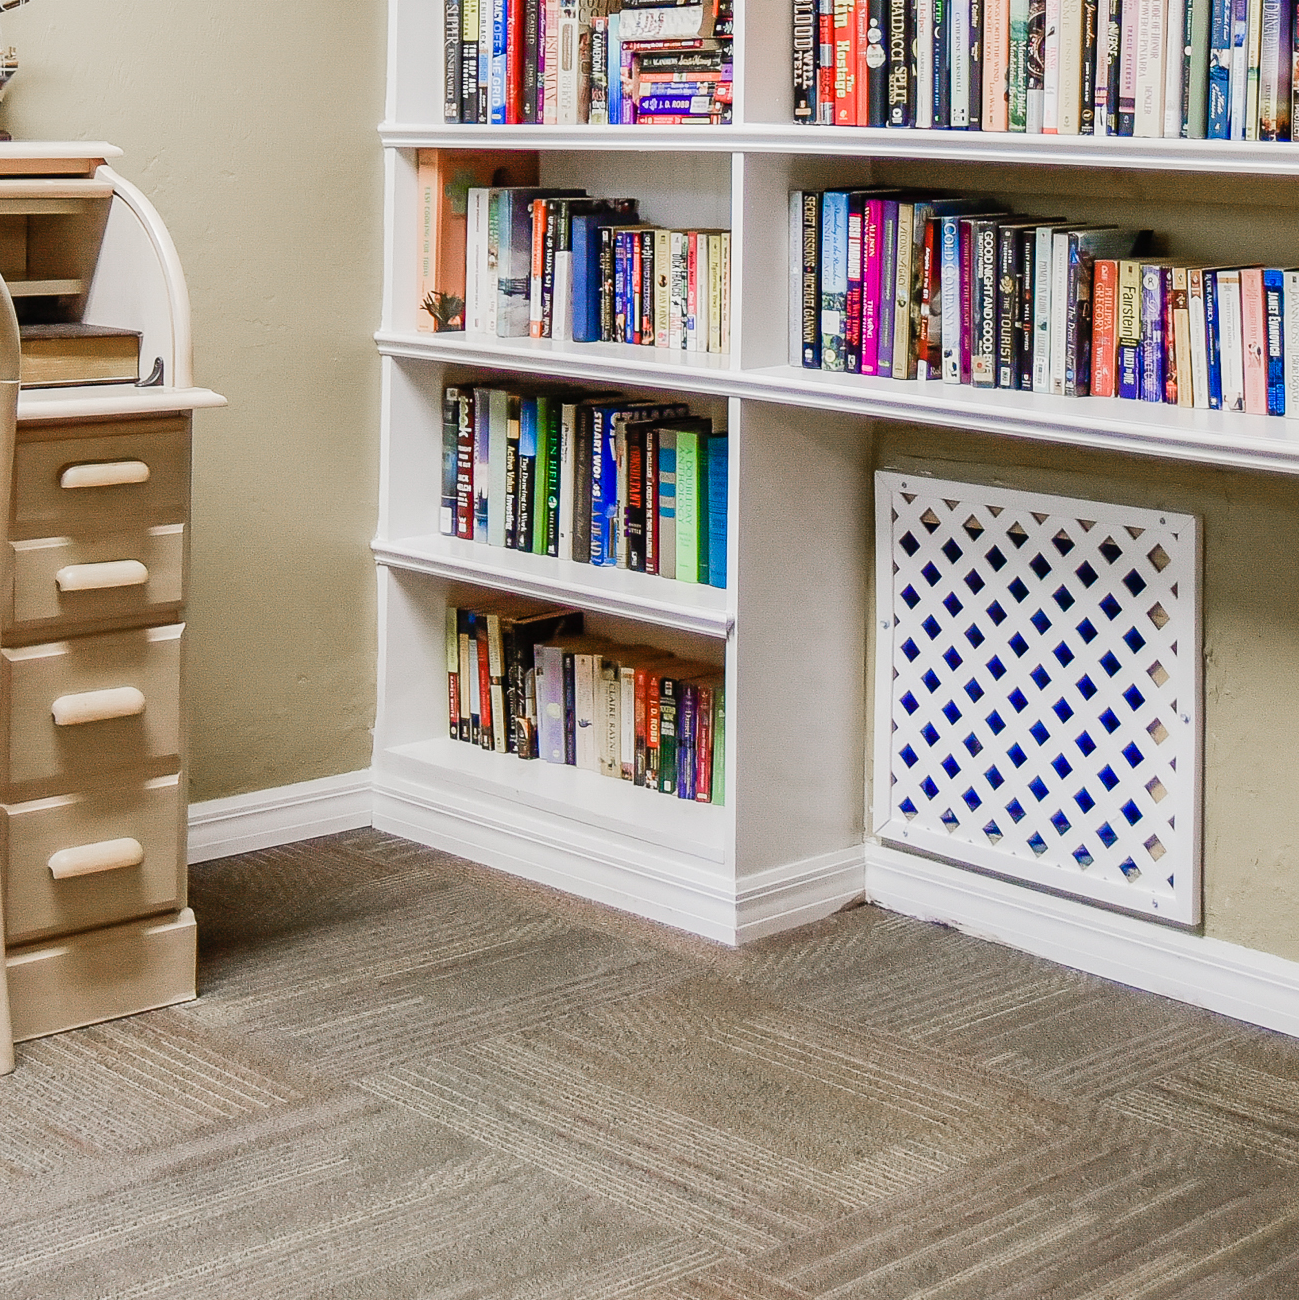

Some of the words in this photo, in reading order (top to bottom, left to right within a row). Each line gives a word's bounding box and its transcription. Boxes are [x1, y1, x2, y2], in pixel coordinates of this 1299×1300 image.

[494, 24, 502, 48] OFF
[592, 33, 603, 71] CAMERON
[493, 50, 501, 73] THE
[794, 52, 802, 87] TELL
[803, 51, 813, 90] WILL
[835, 40, 851, 98] Hostage
[492, 76, 500, 107] GRID
[894, 66, 908, 104] SPLIT
[804, 196, 817, 225] SECRET
[804, 227, 816, 267] MISSIONS
[944, 222, 957, 261] COLD
[803, 272, 815, 308] MICHAEL
[944, 263, 956, 328] COMPANY
[1095, 282, 1104, 333] GREGORY
[1104, 287, 1113, 330] PHILIPPA
[1268, 291, 1280, 316] JANET
[803, 309, 815, 343] GANNON
[1123, 285, 1136, 338] Fairstein
[1003, 312, 1012, 364] TOURIST
[1268, 316, 1282, 357] EVANOVICH
[507, 445, 516, 469] Active
[506, 471, 515, 493] Value
[685, 460, 693, 526] DOUBLEDAY
[505, 494, 515, 531] Investing
